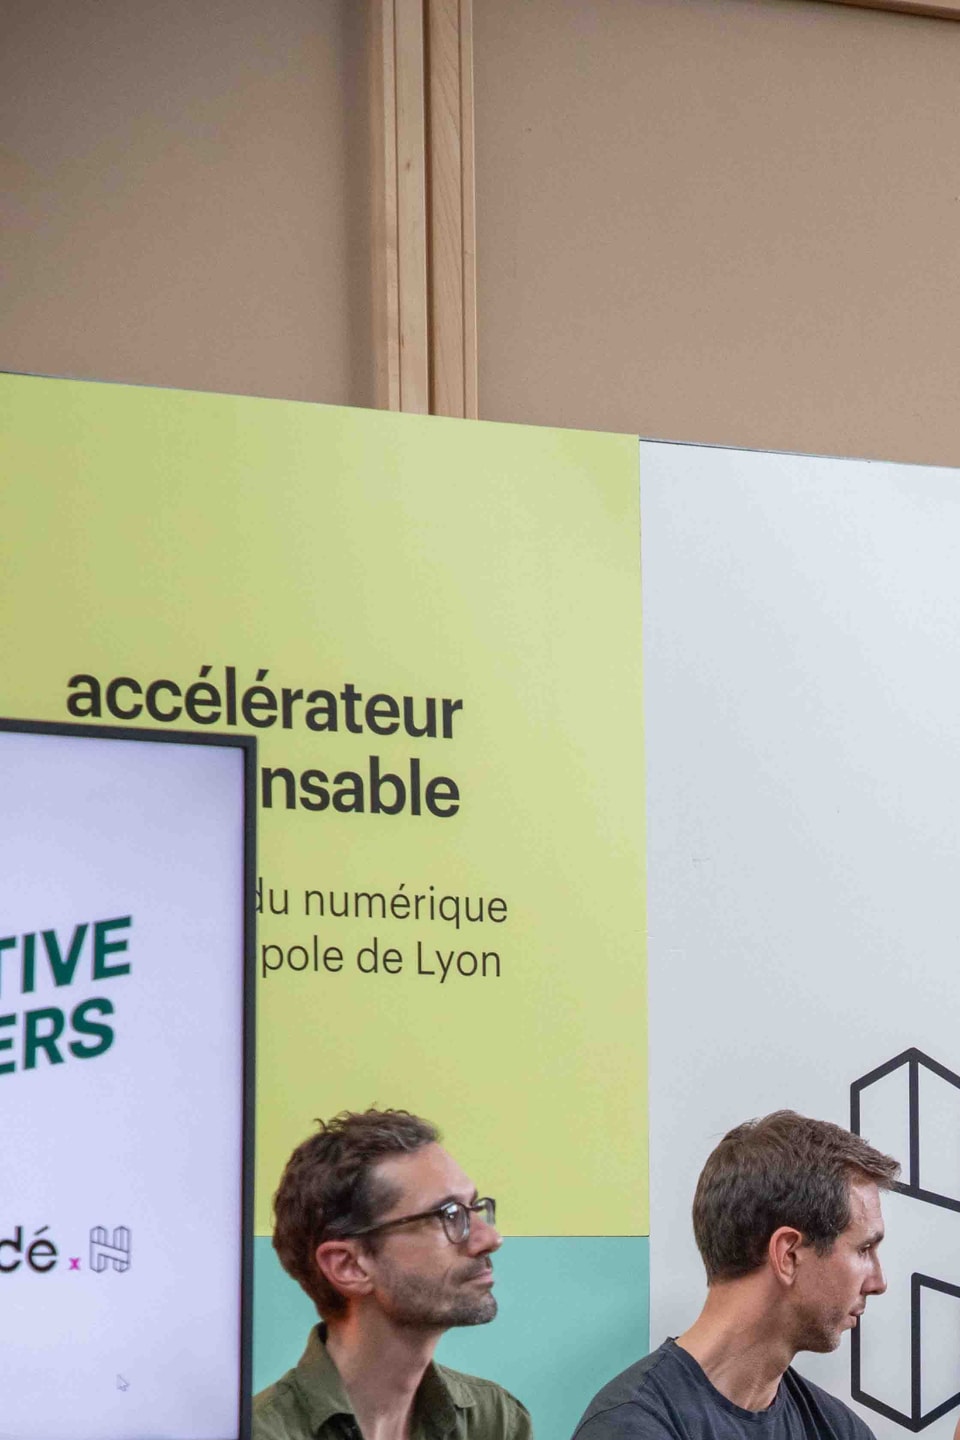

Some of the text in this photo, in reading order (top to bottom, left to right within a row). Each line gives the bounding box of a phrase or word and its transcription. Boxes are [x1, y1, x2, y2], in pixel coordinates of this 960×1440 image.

[67, 665, 463, 739] accélérateur
[262, 756, 460, 817] nsable
[305, 883, 509, 930] numérique
[262, 935, 501, 984] pole de Lyon
